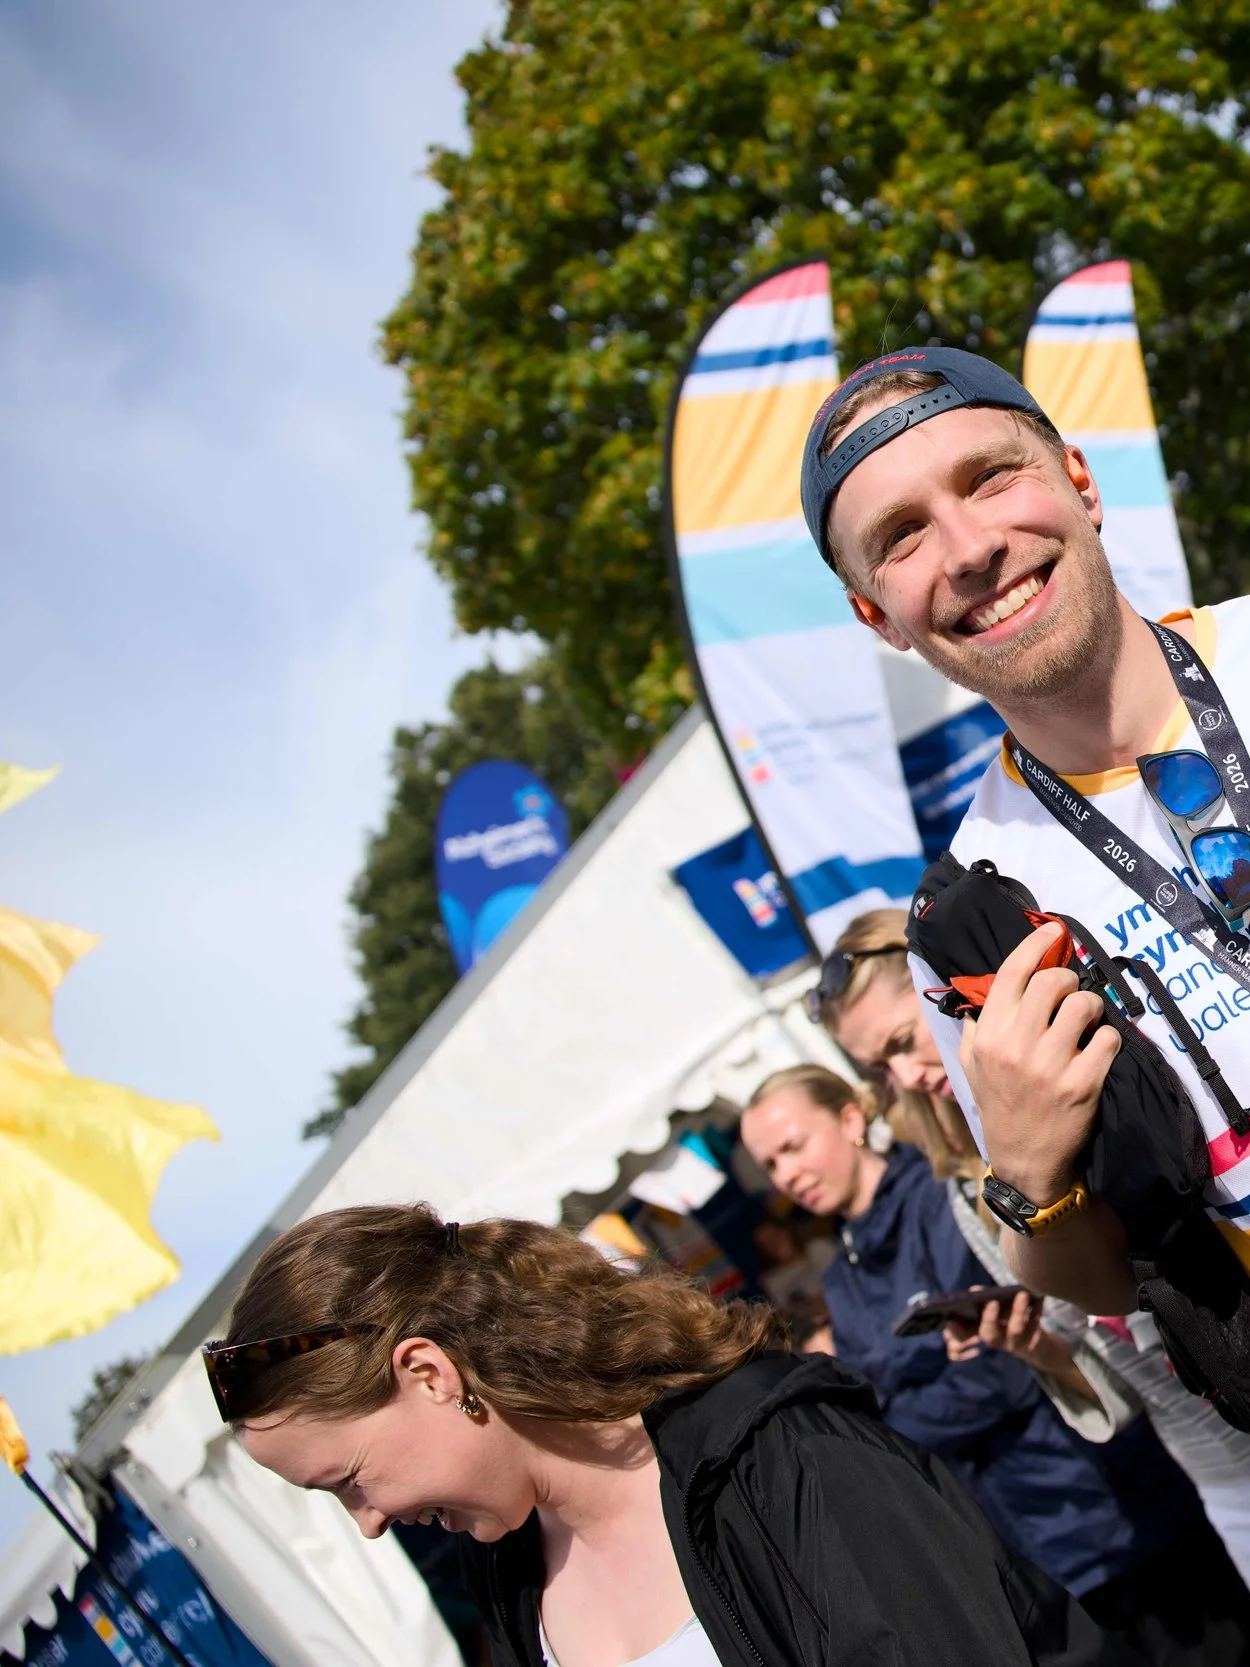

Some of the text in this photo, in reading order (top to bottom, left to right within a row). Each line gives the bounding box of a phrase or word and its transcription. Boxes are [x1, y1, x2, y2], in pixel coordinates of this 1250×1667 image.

[1026, 759, 1064, 798] CARDIFF
[1063, 794, 1091, 822] HALF
[1223, 753, 1249, 793] 2026
[1103, 839, 1137, 873] 2026
[1218, 952, 1243, 976] HANNER
